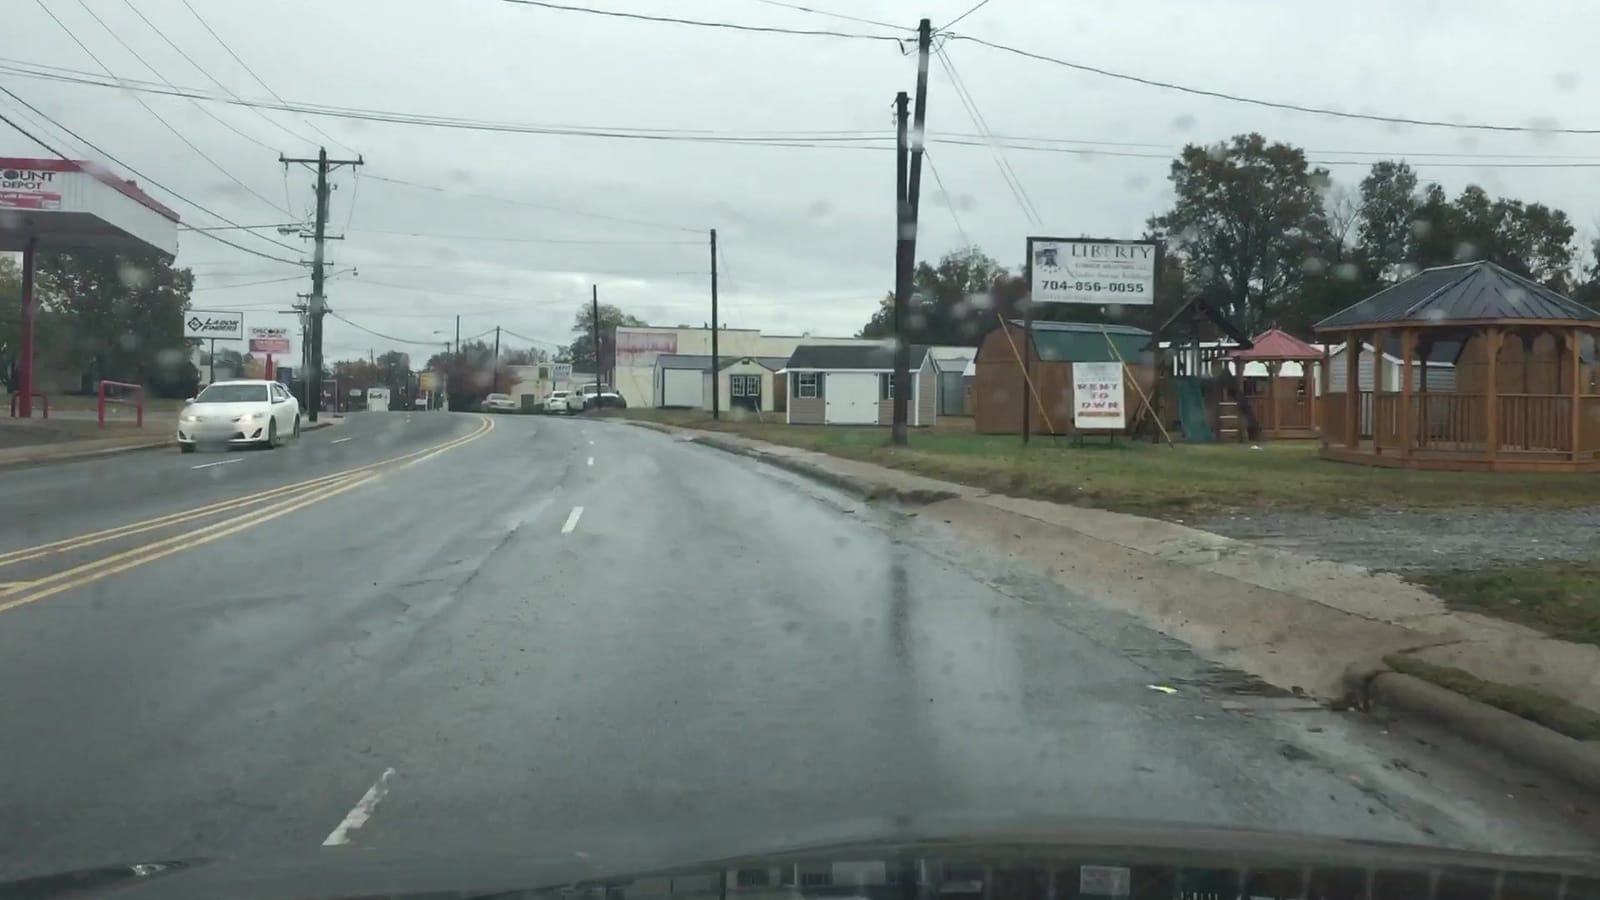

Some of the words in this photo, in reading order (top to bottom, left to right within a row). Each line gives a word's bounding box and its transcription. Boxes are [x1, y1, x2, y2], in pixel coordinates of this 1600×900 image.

[0, 169, 56, 182] OUNT
[2, 181, 41, 189] DEPOT
[1072, 244, 1151, 259] LIBERTY
[1041, 280, 1144, 293] 704-856-0055
[1077, 383, 1118, 391] RENT
